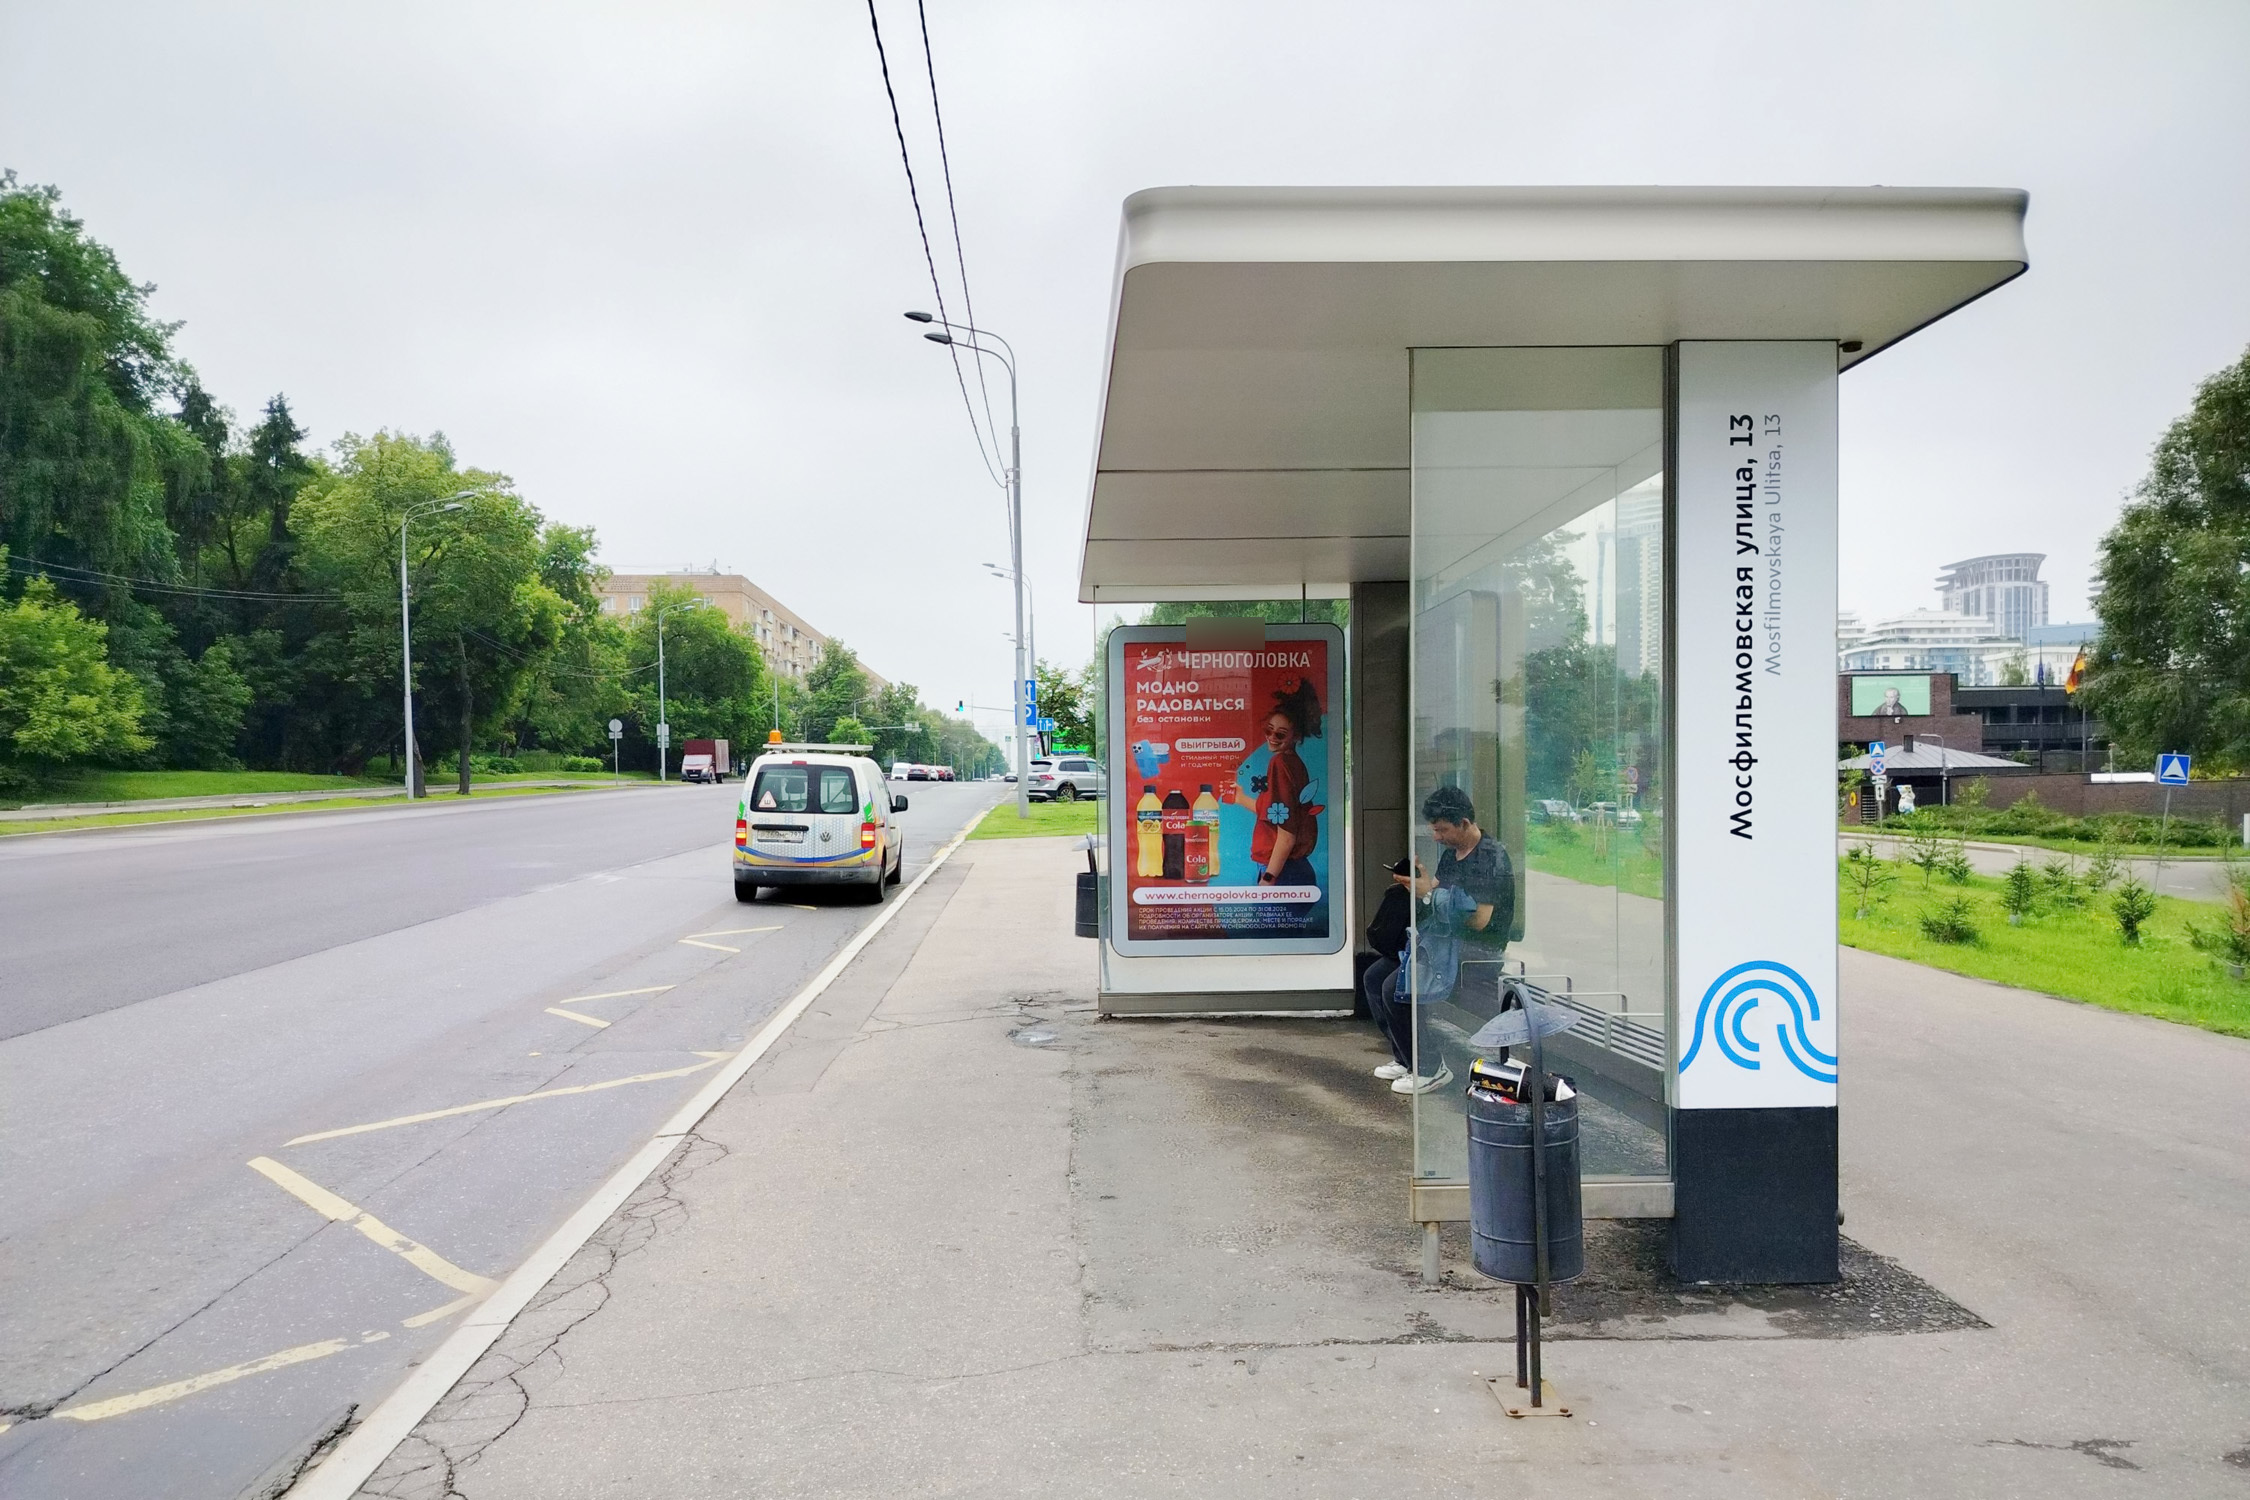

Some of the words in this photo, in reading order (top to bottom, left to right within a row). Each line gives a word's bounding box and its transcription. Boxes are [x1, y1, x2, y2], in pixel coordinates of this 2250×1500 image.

[1729, 414, 1754, 446] 13
[1764, 414, 1781, 436] 13
[1763, 444, 1784, 505] Ulitsa,
[1736, 458, 1759, 555] улица,
[1763, 512, 1785, 676] Mosfilmovskaya
[1177, 650, 1311, 669] ЧЕРНОГОЛОВКА
[1136, 681, 1199, 695] МОДНО
[1136, 698, 1245, 713] РАДОВАТЬСЯ
[1728, 566, 1758, 840] Мосфильмовская
[1137, 715, 1154, 723] без
[1158, 715, 1211, 723] остановки
[1181, 740, 1241, 749] ВЫИГРЫВАЙ
[1166, 821, 1186, 830] Cola
[1186, 855, 1207, 864] Cola
[1145, 890, 1311, 901] www.chernogolovka-promo.ru
